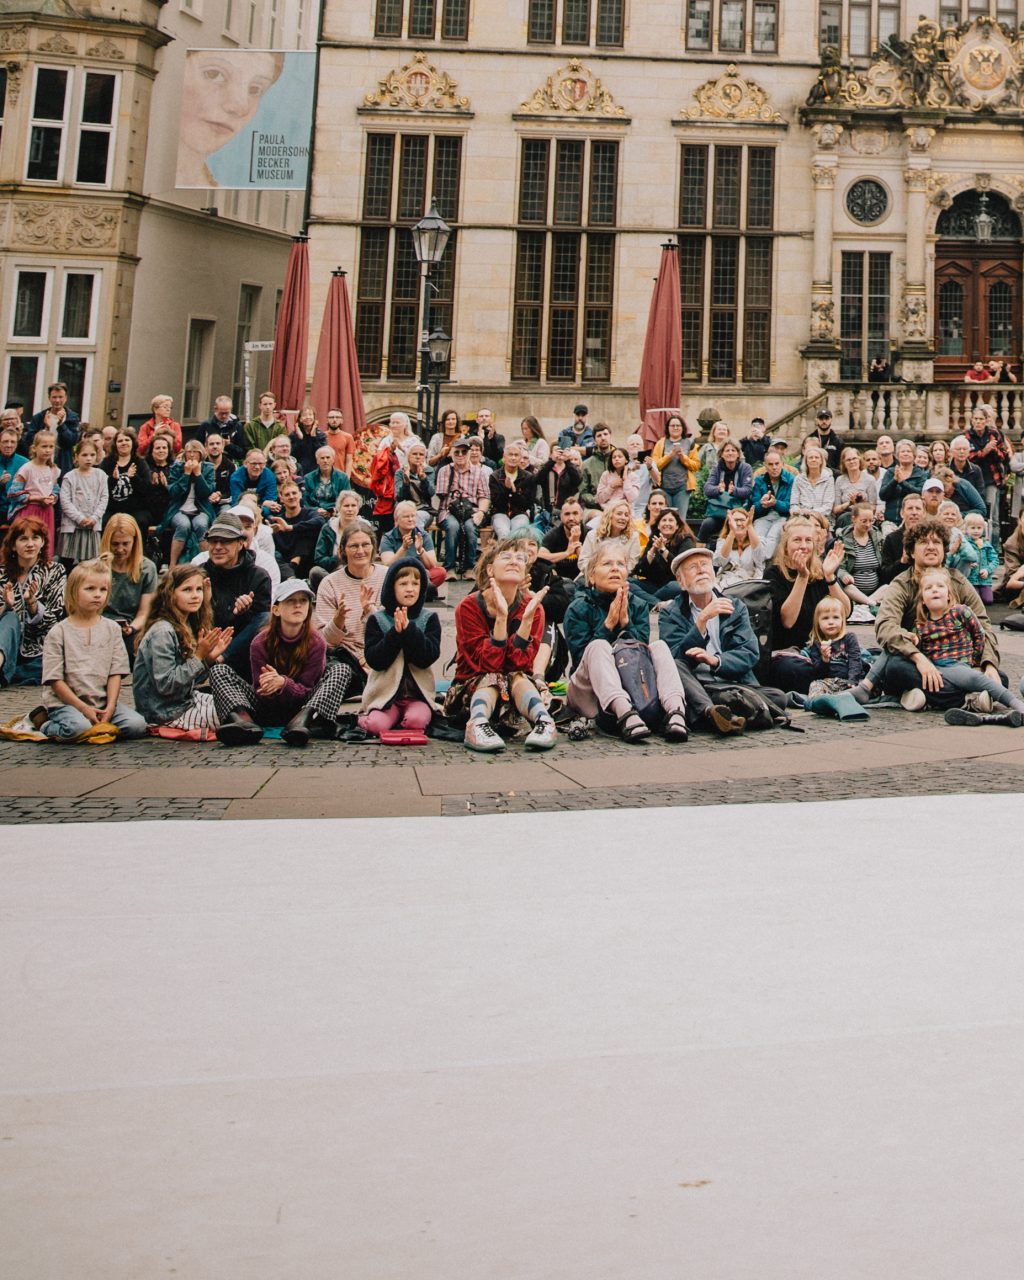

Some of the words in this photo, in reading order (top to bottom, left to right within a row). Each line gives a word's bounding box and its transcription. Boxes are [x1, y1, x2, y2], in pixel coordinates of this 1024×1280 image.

[259, 134, 285, 145] PAULA
[258, 146, 309, 157] MODERSOHN
[257, 157, 290, 168] BECKER
[256, 169, 294, 180] MUSEUM
